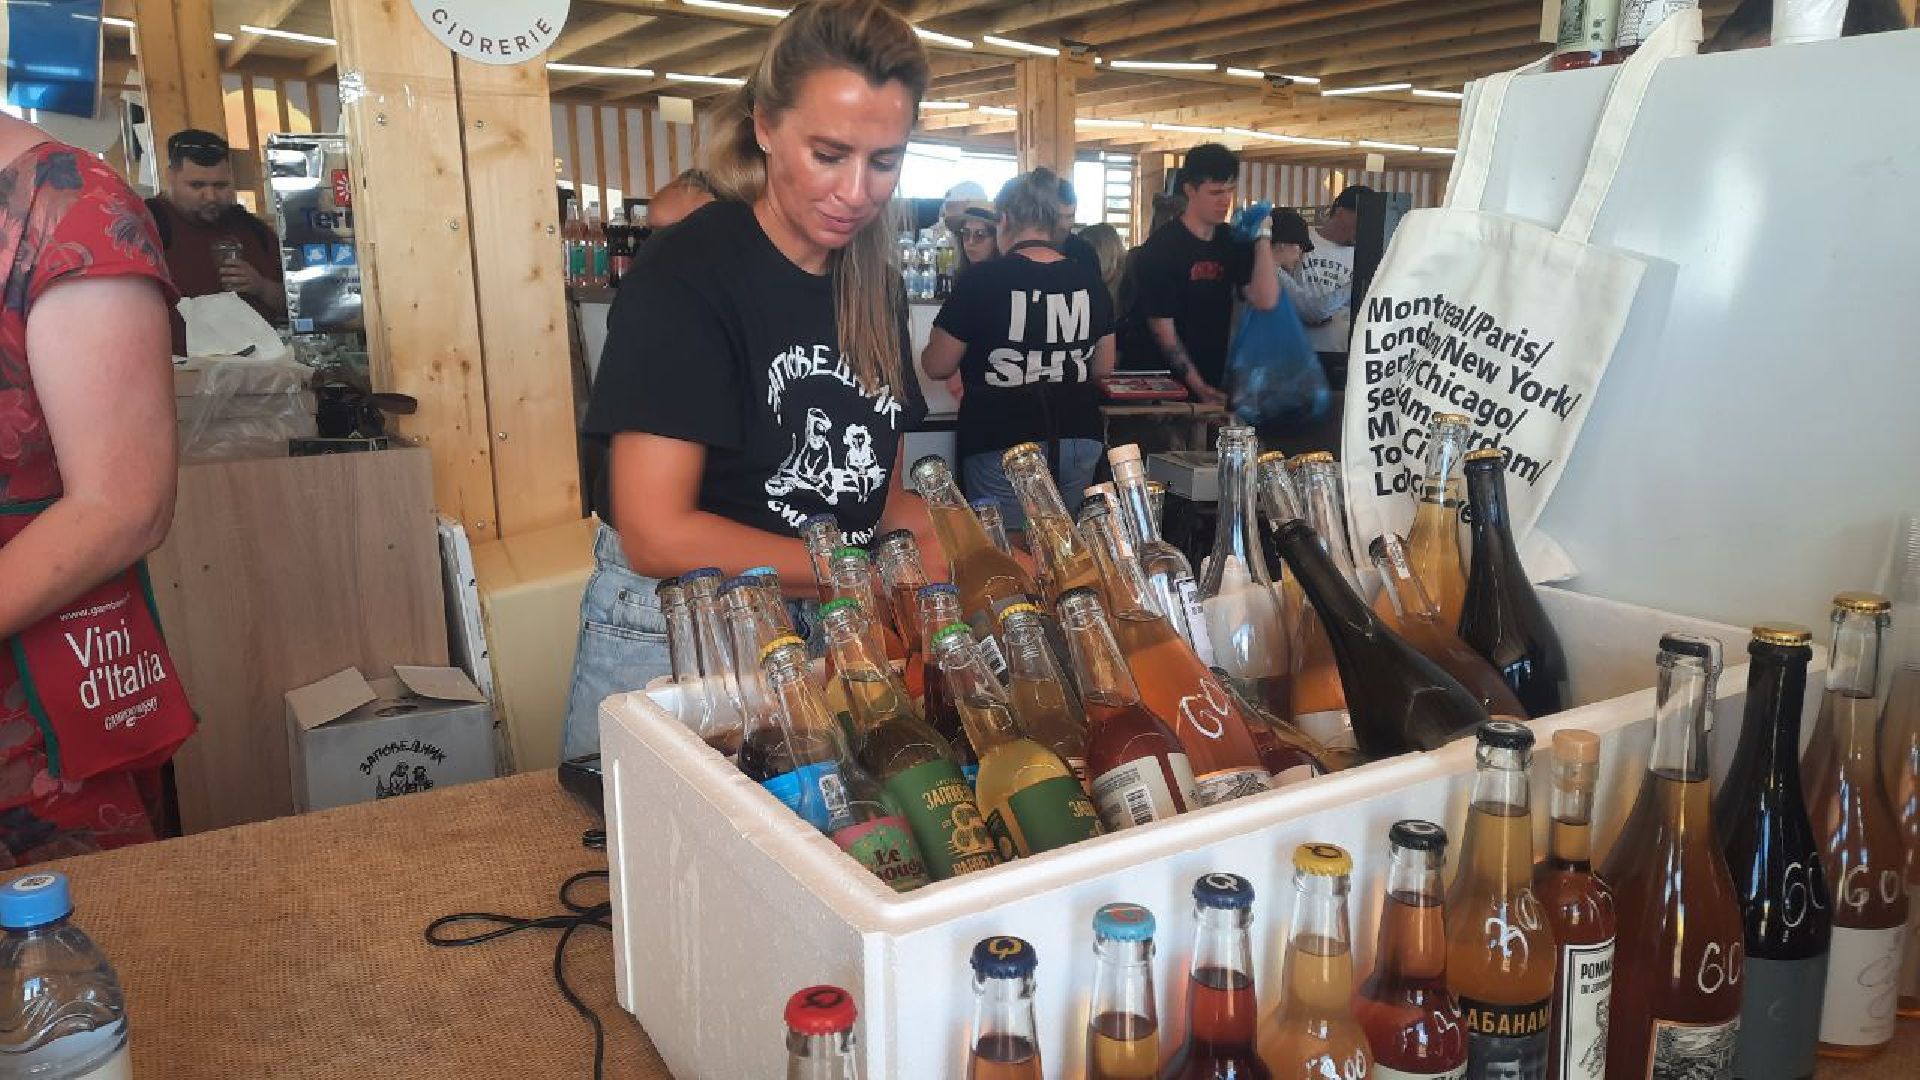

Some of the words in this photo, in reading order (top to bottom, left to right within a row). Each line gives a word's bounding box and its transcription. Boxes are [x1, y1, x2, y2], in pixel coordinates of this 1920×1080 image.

[432, 8, 552, 55] CIDRERIE
[1008, 288, 1090, 343] I'M
[985, 345, 1095, 387] SHY
[1508, 365, 1582, 421] York/
[64, 618, 131, 668] Vini
[80, 650, 166, 709] d'Italia
[360, 740, 447, 775] ЗАПОВЕДНИК
